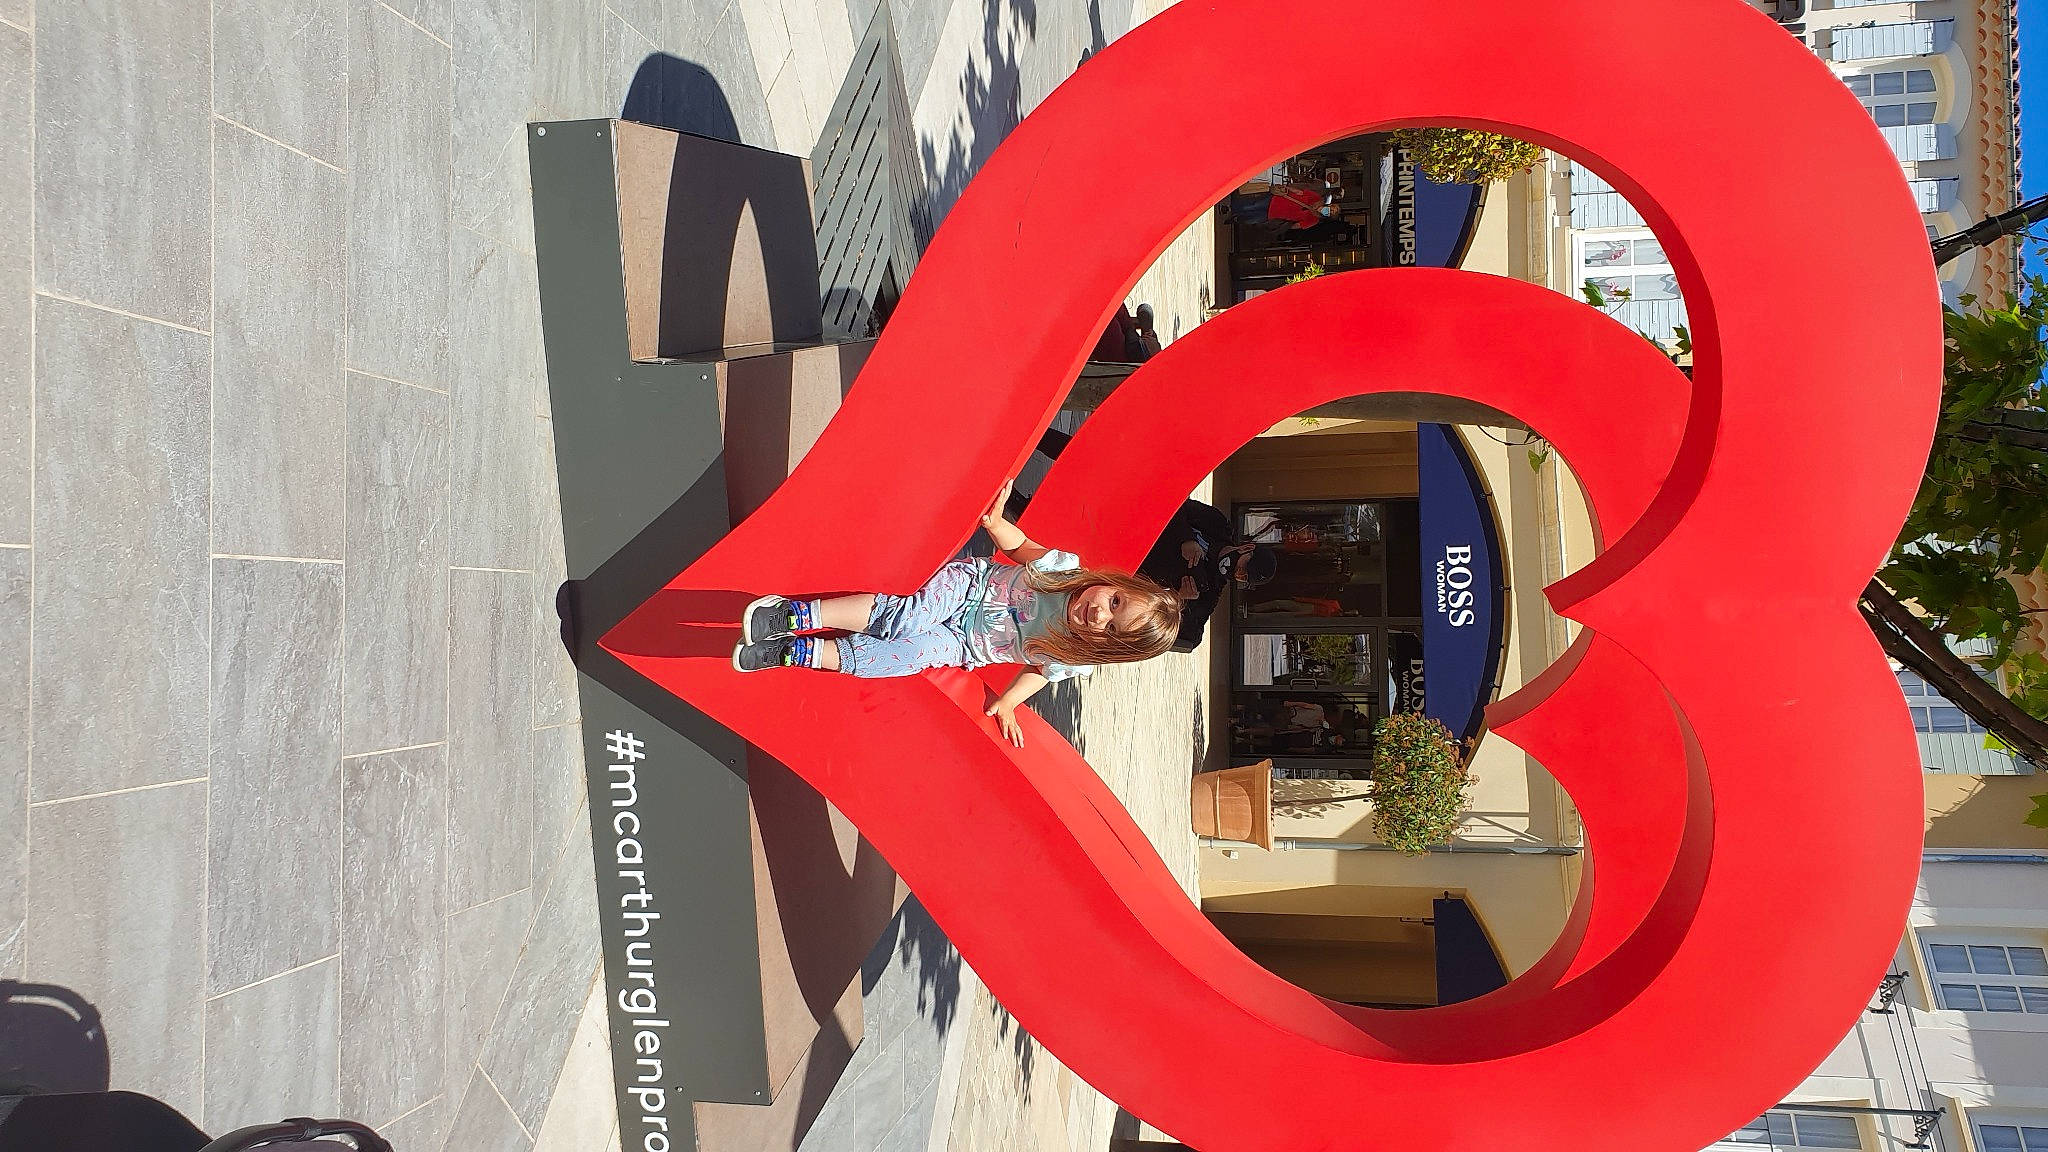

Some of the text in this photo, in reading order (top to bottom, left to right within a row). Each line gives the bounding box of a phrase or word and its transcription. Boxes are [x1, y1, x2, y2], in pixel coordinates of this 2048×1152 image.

[1398, 148, 1416, 265] PRINTEMPS
[1436, 560, 1447, 613] WOMAN
[1446, 545, 1475, 627] BOSS
[606, 729, 671, 1152] #mcarthurglenpro
